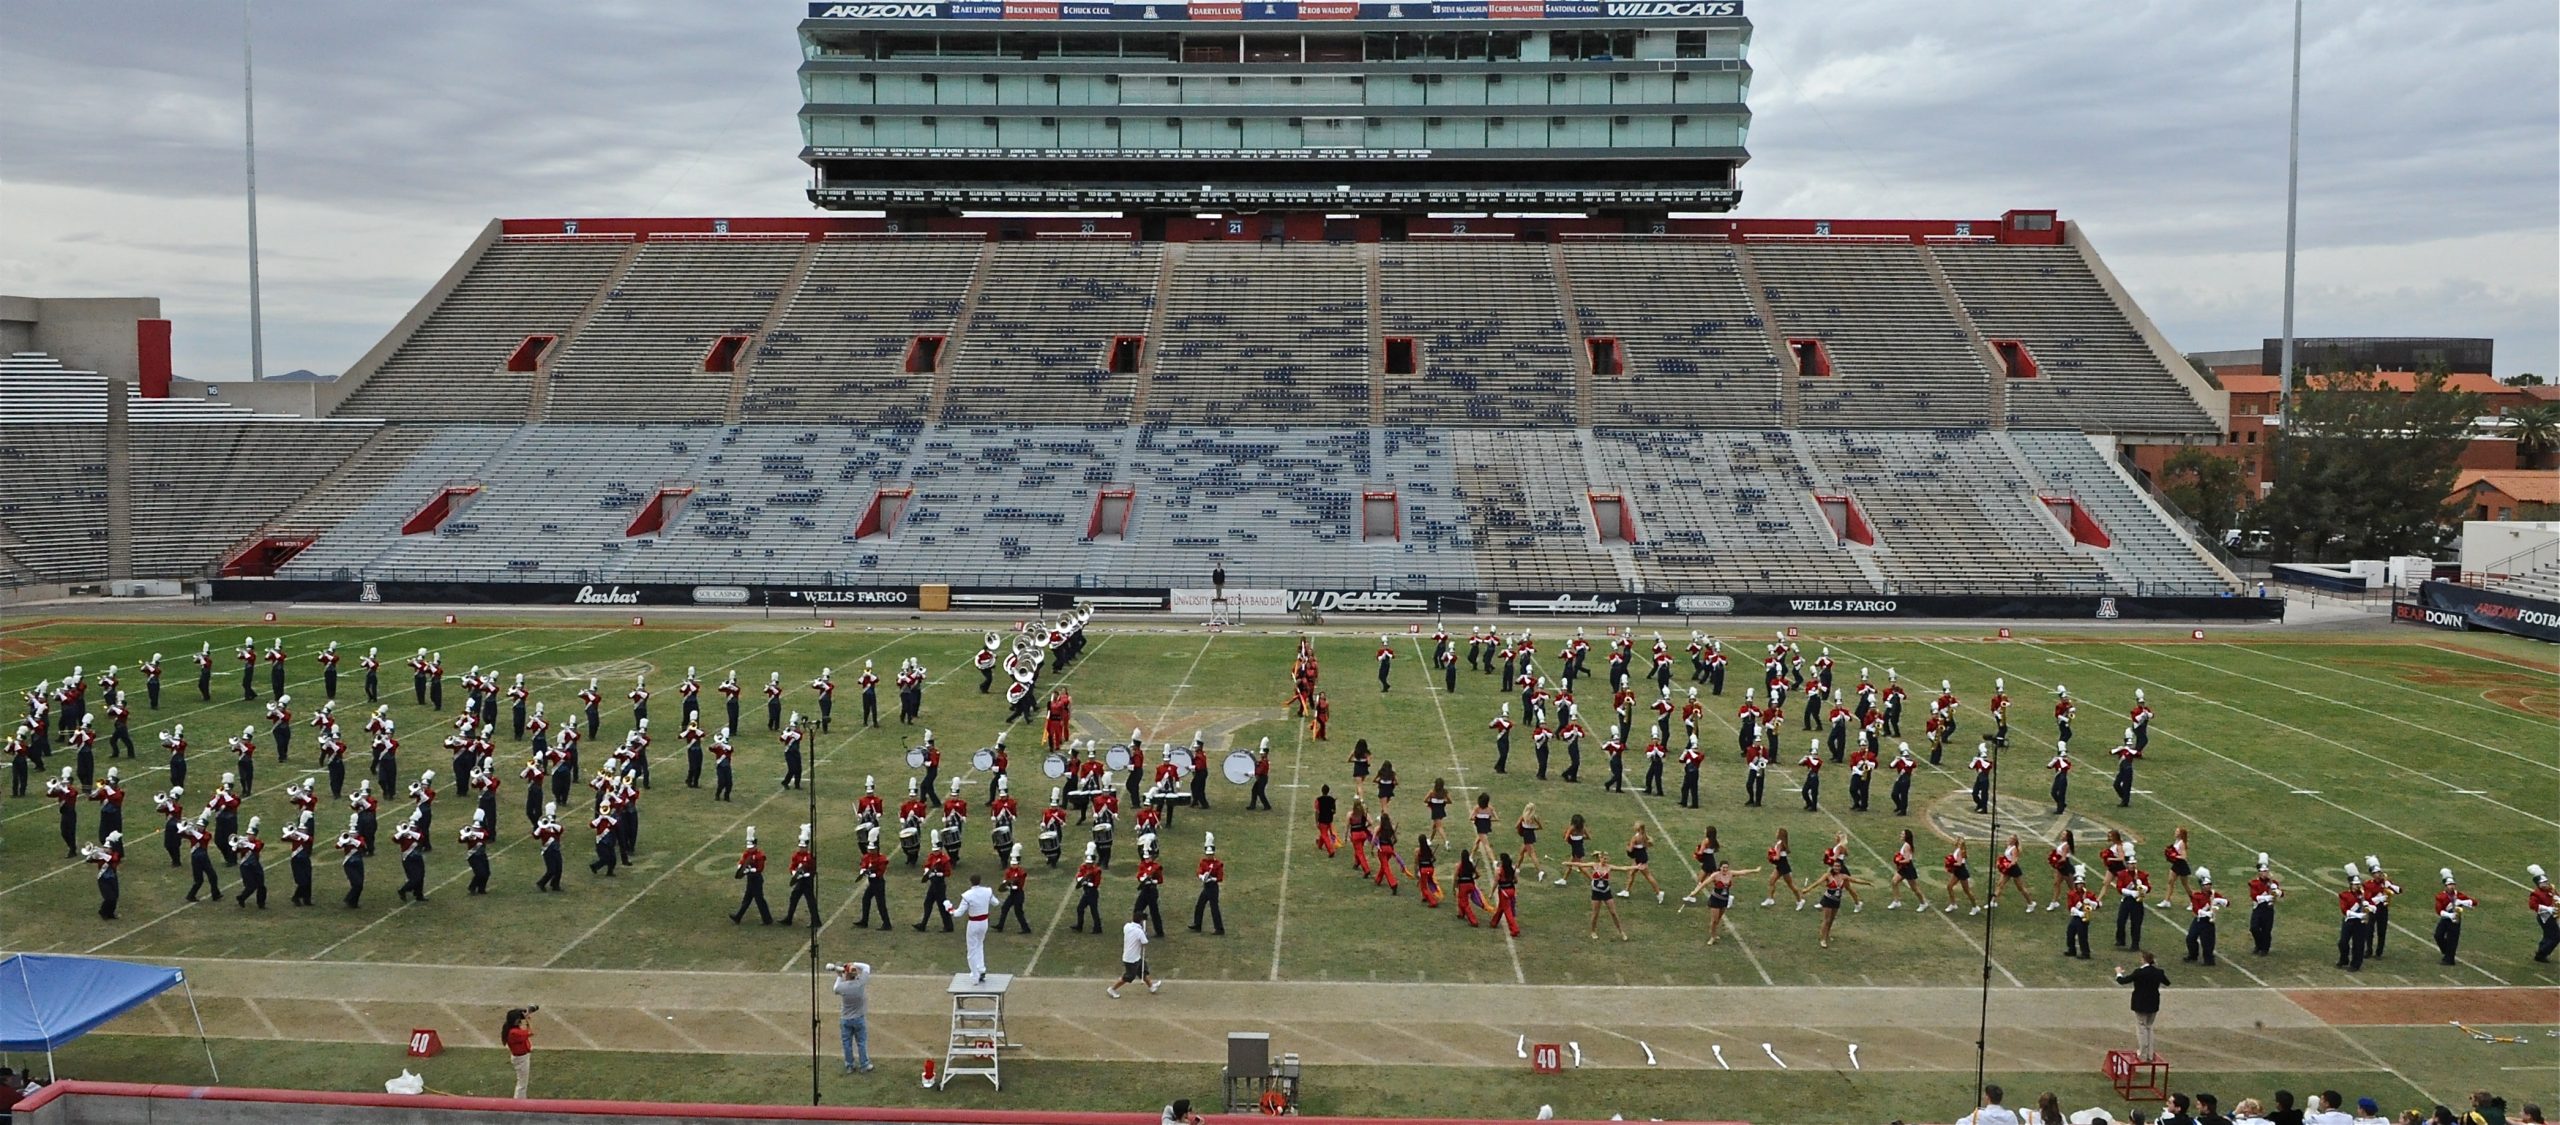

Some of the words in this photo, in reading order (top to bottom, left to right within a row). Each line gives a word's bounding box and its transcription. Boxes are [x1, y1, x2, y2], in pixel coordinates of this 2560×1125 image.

[822, 4, 937, 17] ARIZONA
[952, 5, 959, 13] 22
[1607, 3, 1736, 16] WILDCATS
[566, 226, 576, 234] 17
[716, 225, 726, 233] 18
[888, 224, 898, 233] 19
[1082, 224, 1094, 233] 20
[1230, 224, 1241, 233] 21
[1453, 225, 1465, 234] 22
[1653, 225, 1665, 234] 23
[1816, 227, 1828, 235] 24
[1956, 227, 1969, 235] 25
[208, 387, 218, 395] 16
[574, 585, 640, 603] Bashas'
[803, 591, 854, 602] WELLS
[857, 591, 907, 602] FARGO
[1173, 596, 1208, 606] UNIVERSITY
[1248, 596, 1268, 606] BAND
[1269, 596, 1282, 606] DAY
[1789, 600, 1842, 611] WELLS
[1845, 600, 1896, 611] FARGO
[2474, 603, 2518, 619] ARIZONA
[2396, 606, 2425, 621] BEAR
[2425, 610, 2463, 628] DOWN
[411, 1033, 429, 1053] 40
[1537, 1049, 1556, 1069] 40
